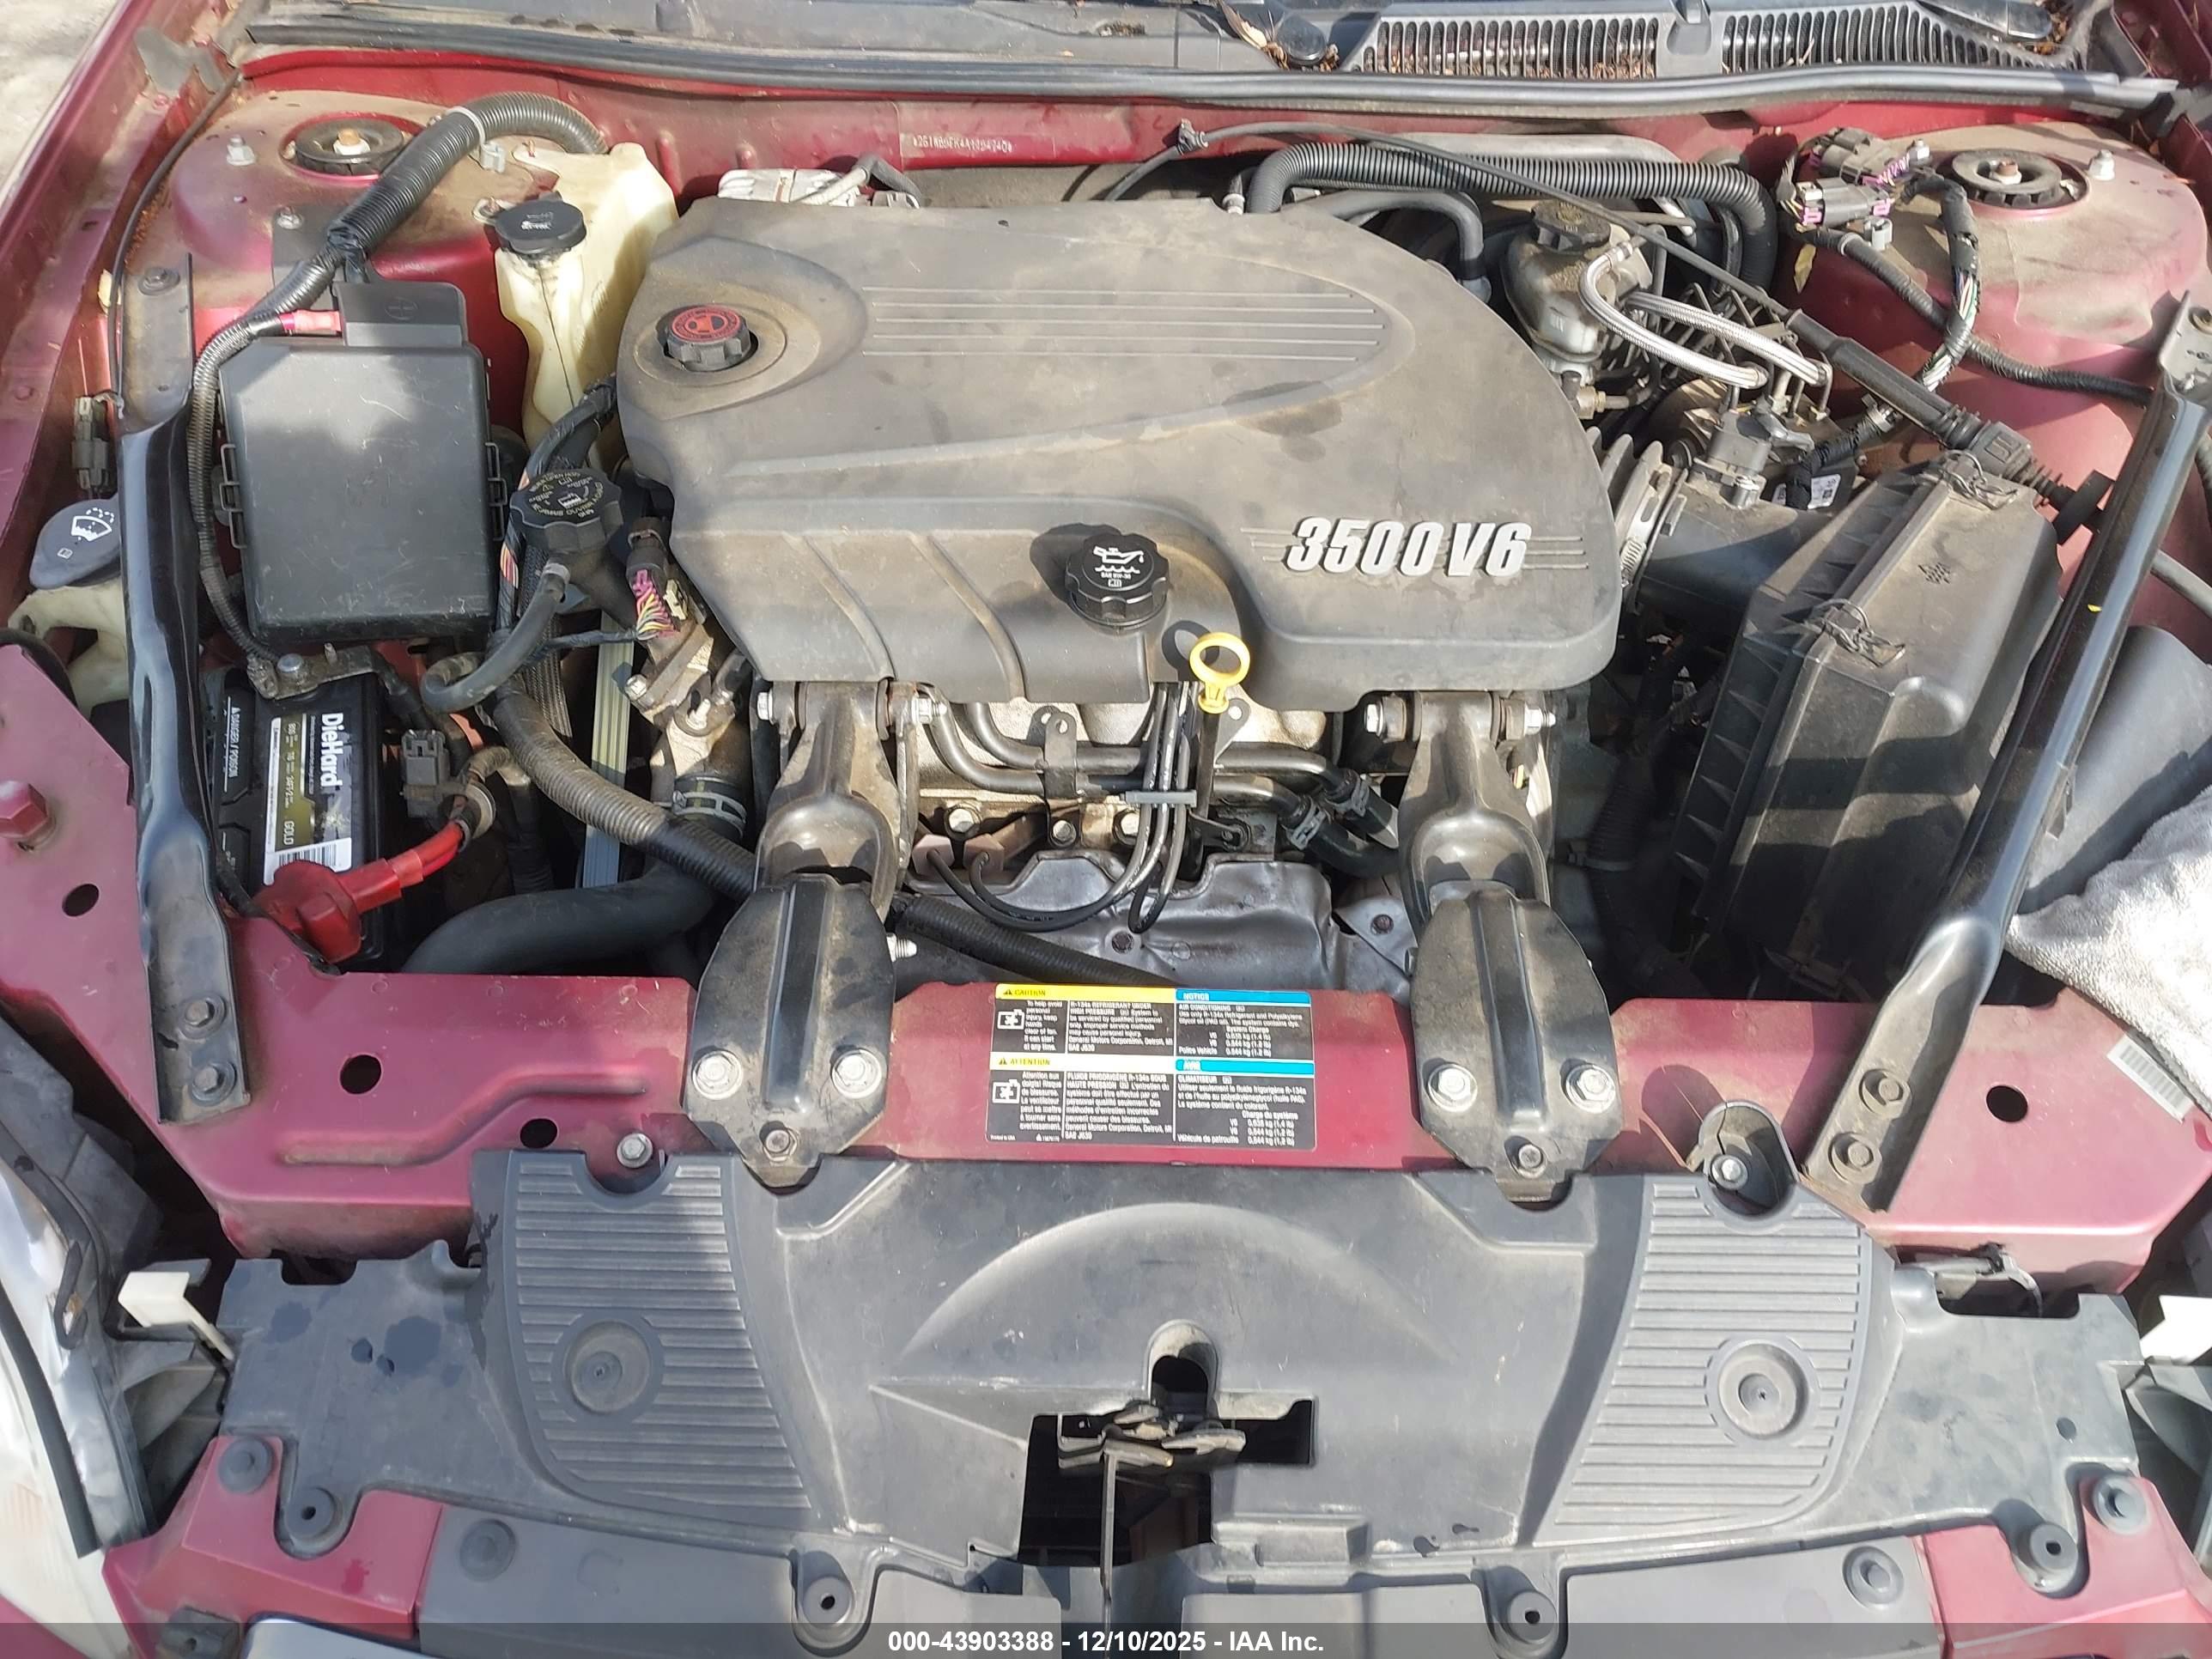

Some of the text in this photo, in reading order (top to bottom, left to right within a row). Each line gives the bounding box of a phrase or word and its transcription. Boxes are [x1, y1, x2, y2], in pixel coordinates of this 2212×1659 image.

[1286, 516, 1533, 577] 3500 V6
[320, 713, 343, 787] DieHard
[283, 821, 295, 846] GOLD
[1183, 993, 1210, 1001] NOTICE
